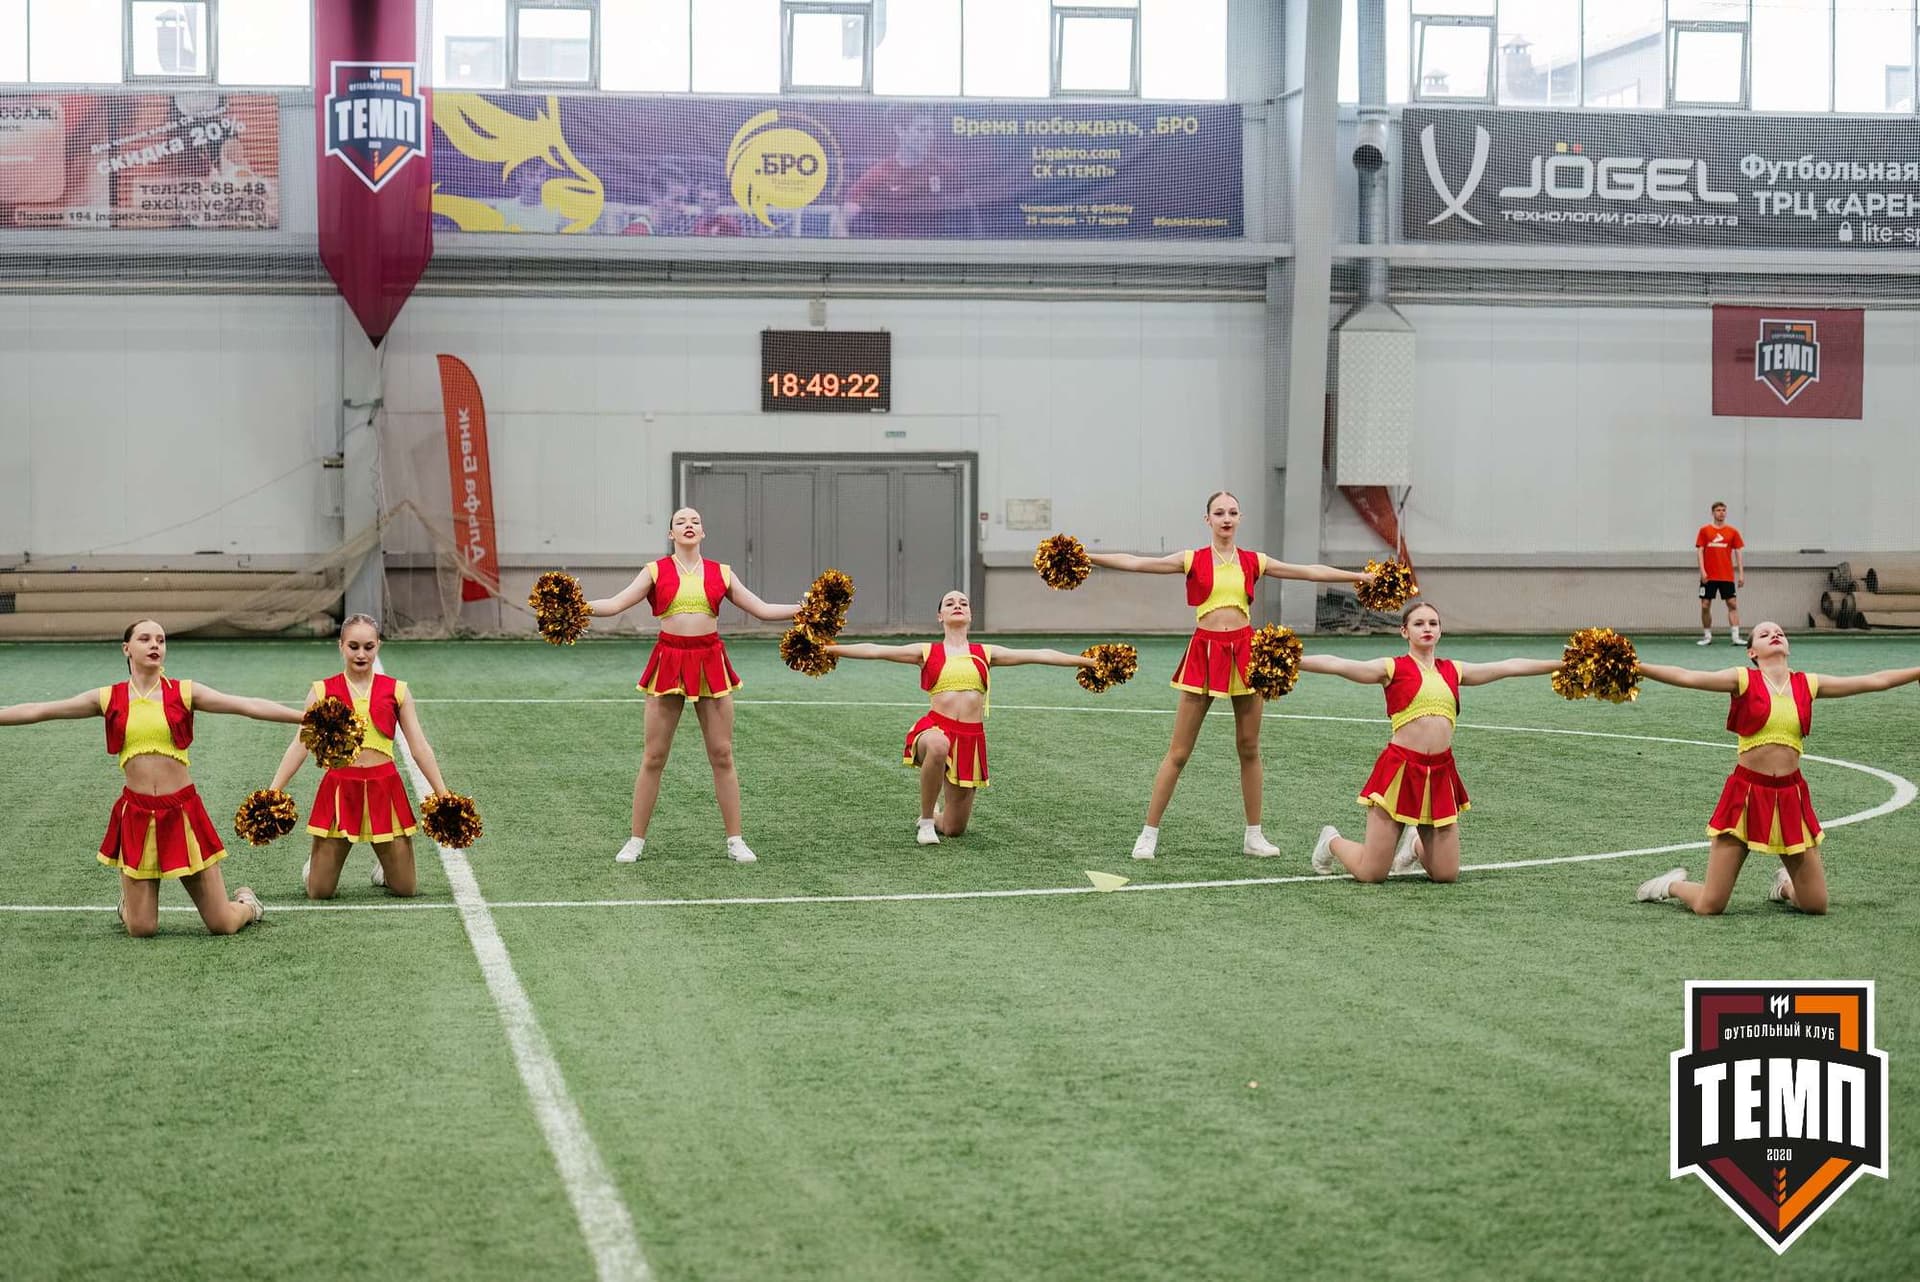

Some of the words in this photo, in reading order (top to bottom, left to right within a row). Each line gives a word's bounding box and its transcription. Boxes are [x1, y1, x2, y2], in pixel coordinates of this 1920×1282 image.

[335, 98, 416, 144] ТЕМП
[952, 116, 1018, 137] Время
[1025, 117, 1144, 137] побеждать,
[96, 137, 185, 175] скидка
[190, 114, 247, 146] 20%
[1032, 147, 1120, 161] Ligabro.com
[1032, 165, 1053, 178] СК
[1499, 142, 1739, 202] JÖGEL
[1741, 153, 1919, 185] Футбольная
[1501, 210, 1618, 222] технологии
[1624, 212, 1739, 227] результата
[1752, 191, 1817, 221] ТРЦ
[1762, 343, 1814, 373] ТЕМП
[767, 373, 880, 397] 18:49:22
